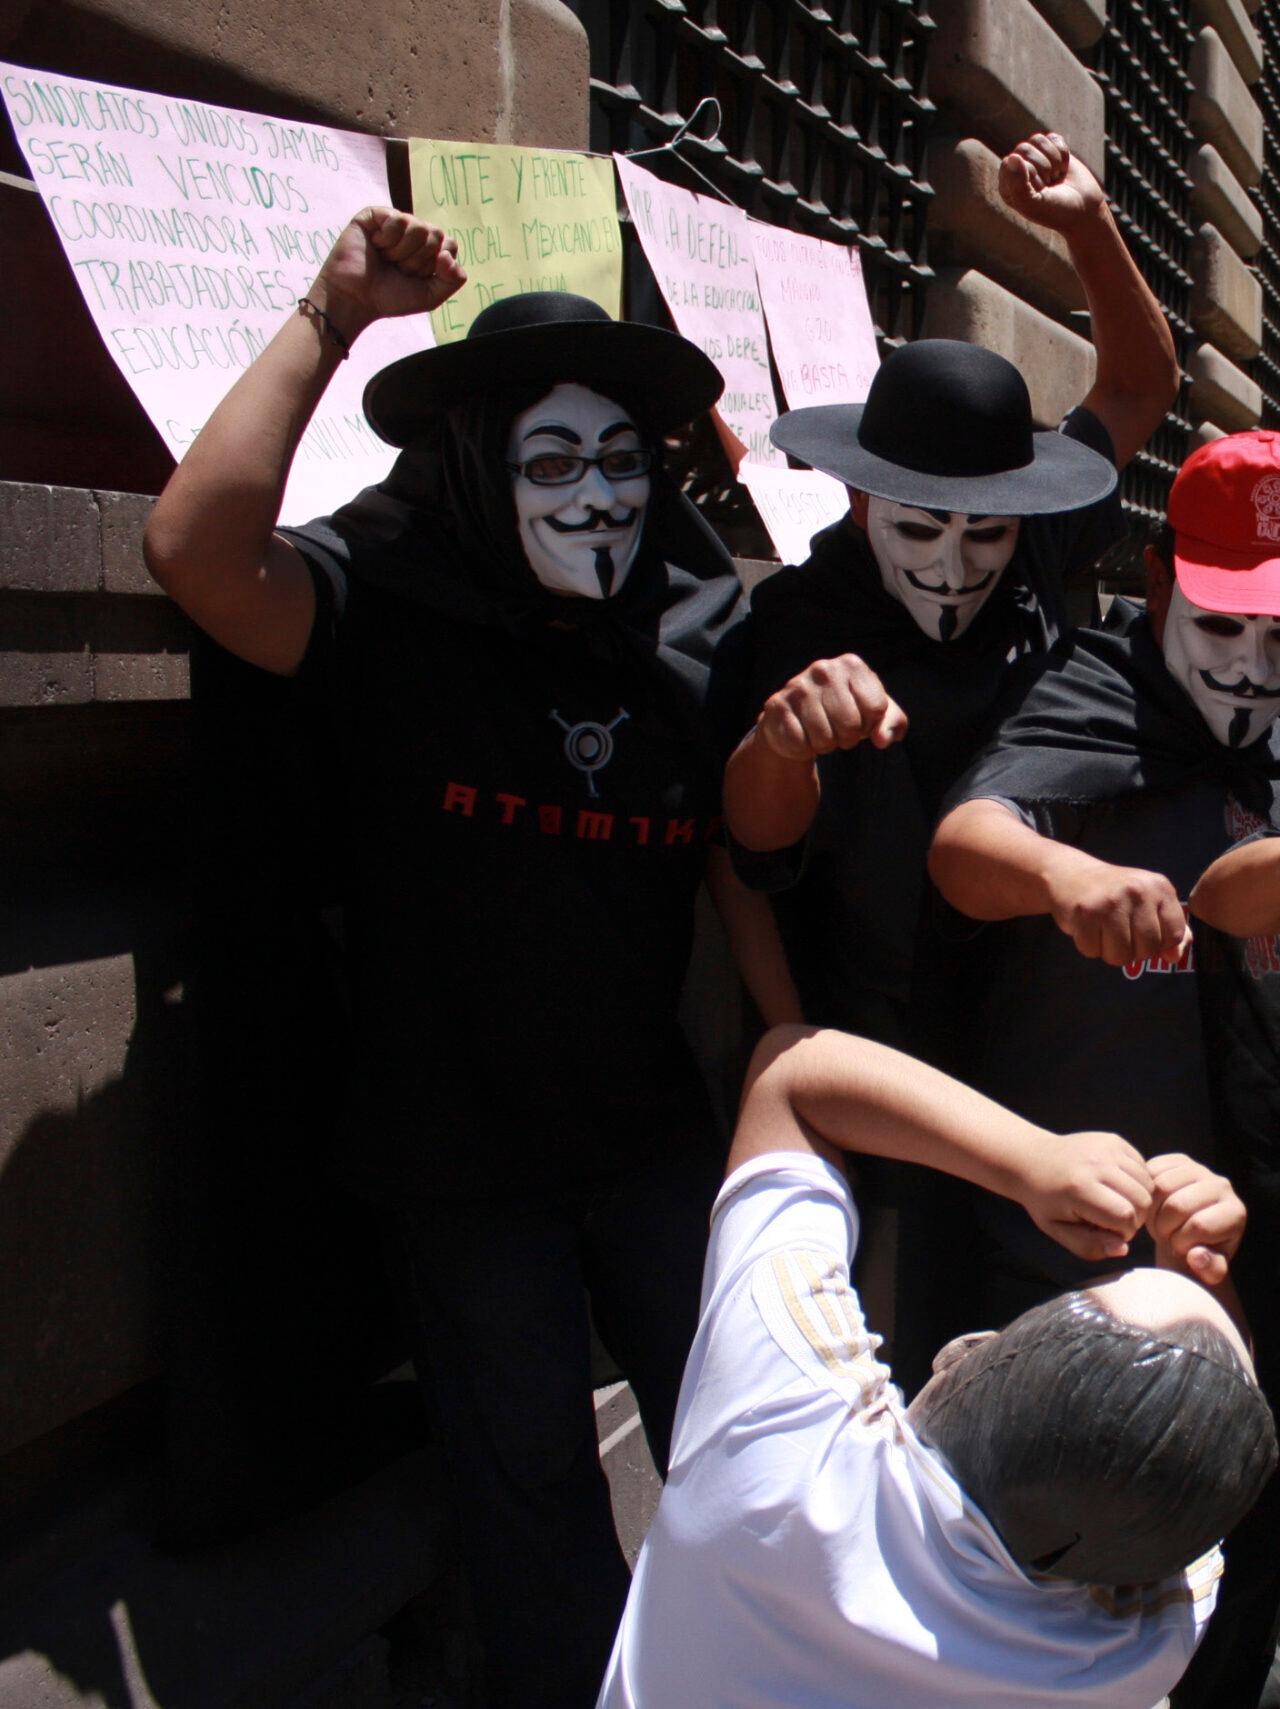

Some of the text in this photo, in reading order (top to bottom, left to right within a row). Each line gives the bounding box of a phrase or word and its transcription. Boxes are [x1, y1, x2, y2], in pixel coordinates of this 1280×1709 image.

[4, 76, 160, 139] SINDICATOS
[166, 103, 259, 156] UNIDOS
[157, 153, 309, 214] VENCIDOS
[430, 154, 587, 206] CNTE Y FRENTE
[51, 195, 259, 262] COORDINADORA
[74, 259, 296, 315] TRABAJADORES
[111, 319, 268, 375] EDUCACIÓN
